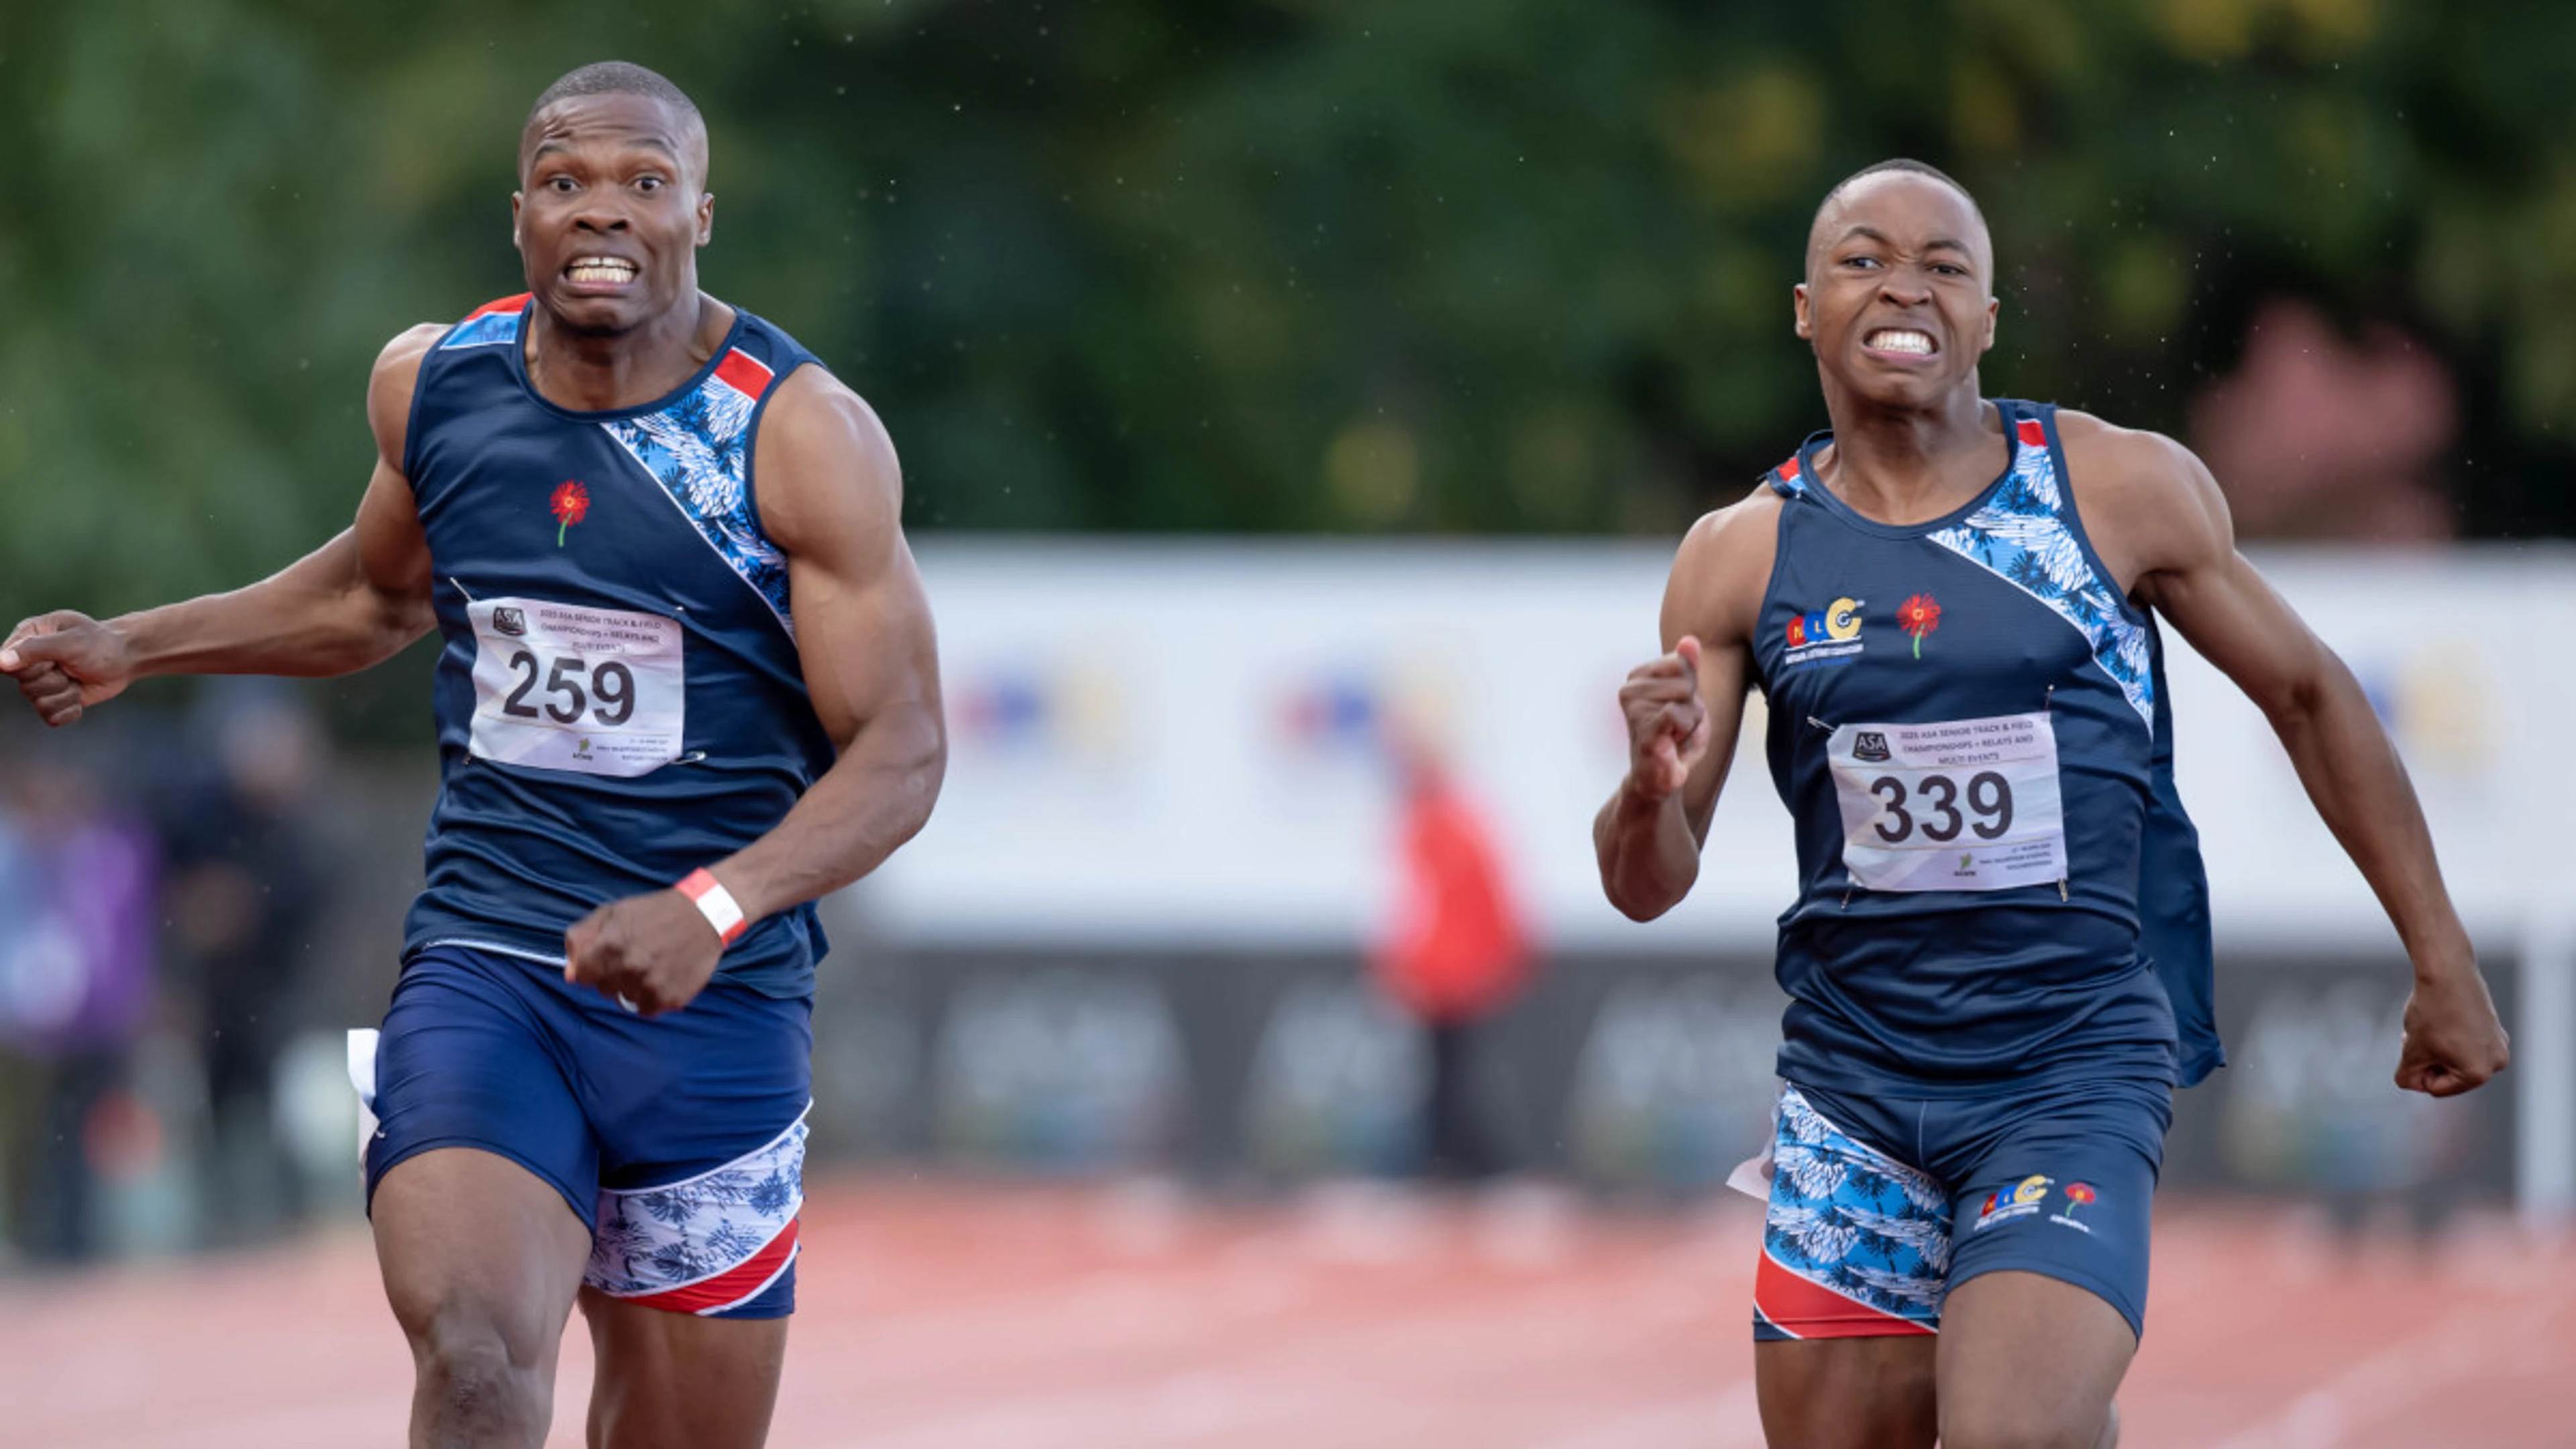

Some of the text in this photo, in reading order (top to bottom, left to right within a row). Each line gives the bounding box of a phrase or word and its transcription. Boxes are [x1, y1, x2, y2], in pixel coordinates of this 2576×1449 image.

[495, 607, 523, 627] ASA
[575, 613, 601, 624] SENIOR
[603, 617, 629, 627] TRACK
[639, 621, 661, 629] FIELD
[541, 623, 601, 638] CHAMPIONSHIPS
[610, 631, 640, 641] RELAYS
[641, 635, 659, 643] AND
[502, 649, 635, 727] 259
[1921, 730, 1937, 738] ASA
[1939, 727, 1971, 737] SENIOR
[1973, 724, 1999, 734] TRACK
[2002, 722, 2010, 731] &
[2011, 721, 2033, 730] FIELD
[1858, 733, 1886, 751] ASA
[1903, 741, 1972, 753] CHAMPIONSHIPS
[1981, 737, 2012, 747] RELAYS
[2015, 734, 2033, 744] AND
[1968, 752, 1999, 763] EVENTS
[1871, 771, 2013, 843] 339
